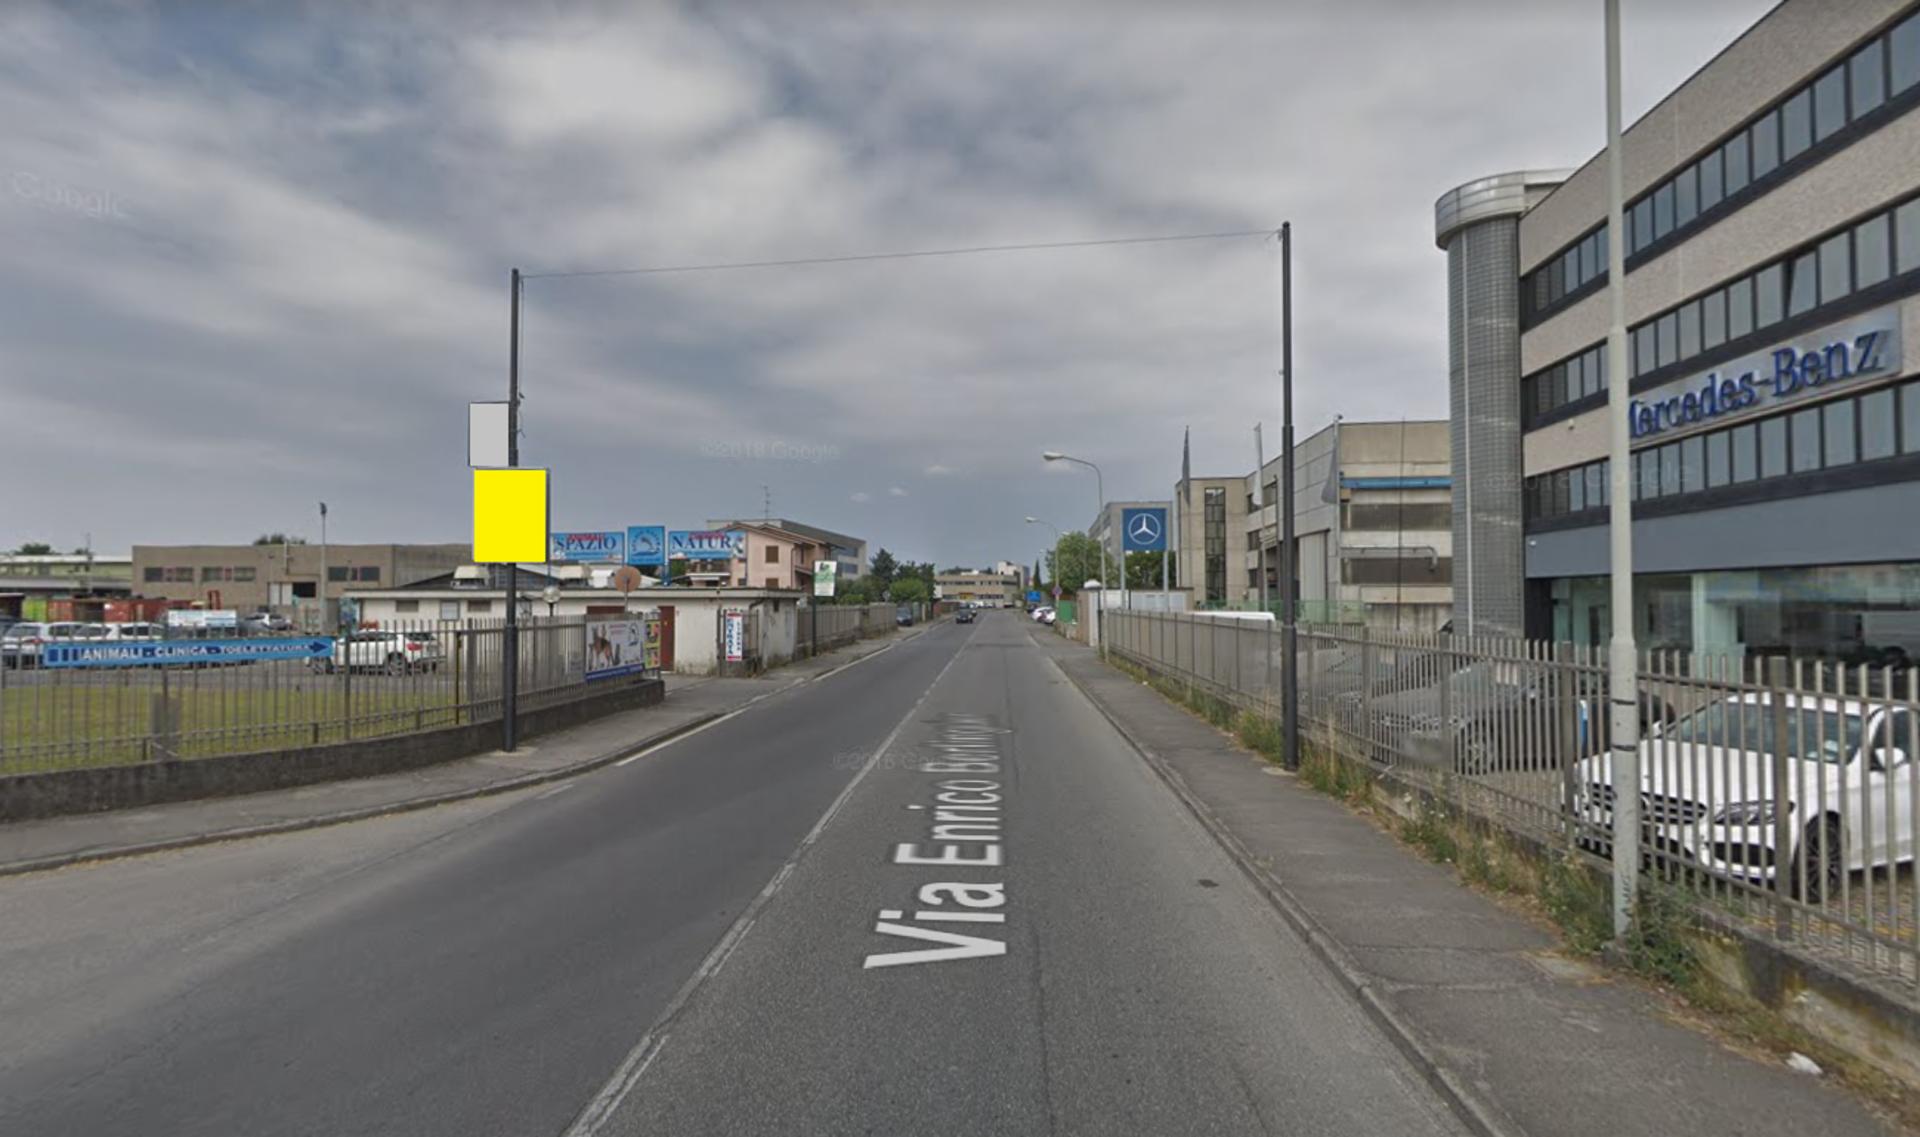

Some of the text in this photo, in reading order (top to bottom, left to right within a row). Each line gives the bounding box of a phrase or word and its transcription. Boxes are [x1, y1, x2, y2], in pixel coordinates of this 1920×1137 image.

[1630, 329, 1890, 438] ercedes-Benz
[555, 536, 617, 550] SPAZIO
[83, 647, 143, 661] ANIMALI
[155, 646, 207, 657] CLINICA
